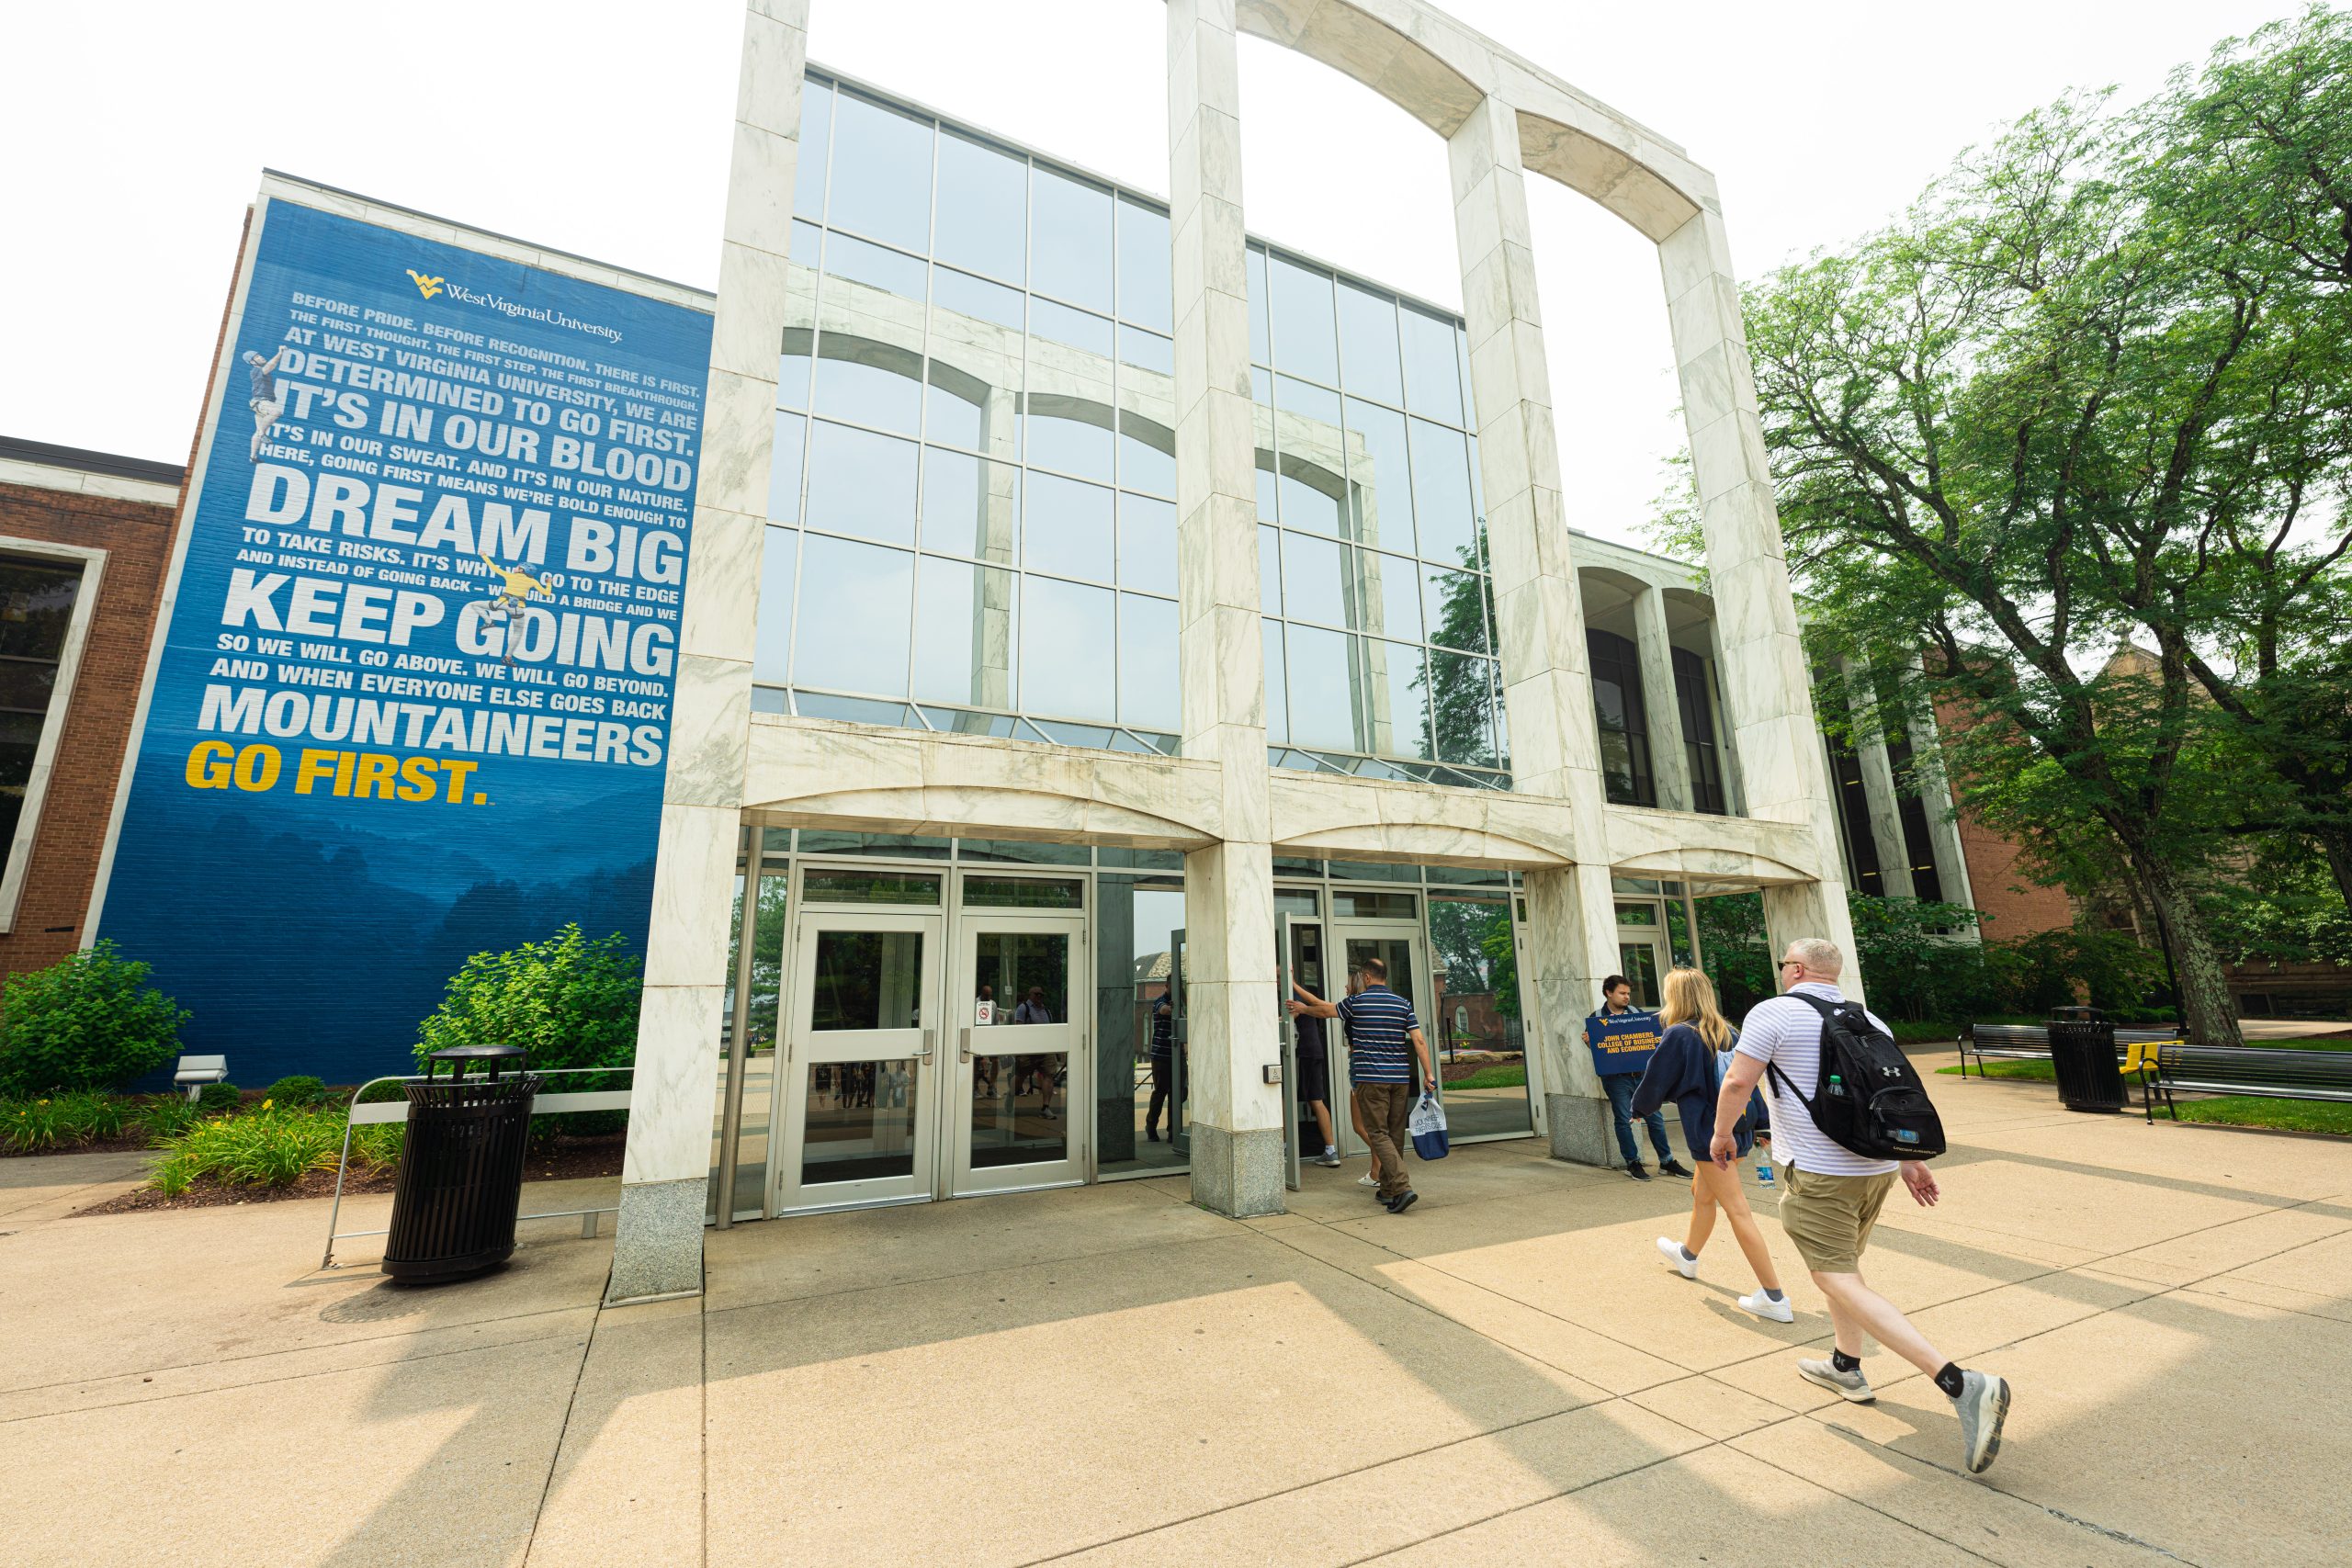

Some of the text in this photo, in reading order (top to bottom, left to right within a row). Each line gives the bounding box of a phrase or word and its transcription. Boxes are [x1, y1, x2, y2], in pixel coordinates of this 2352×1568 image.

[284, 326, 696, 430] AT WEST VIRGINIA UNIVERSITY, WE ARE
[289, 309, 697, 412] THE FIRST THOUGHT. THE FIRST STEP. THE FIRST BREAKTHROUGH.
[292, 291, 699, 398] BEFORE PRIDE. BEFORE RECOGNITION. THERE IS FIRST.
[274, 378, 691, 491] IT'S IN OUR BLOOD
[278, 348, 693, 457] DETERMINED TO GO FIRST.
[258, 443, 685, 528] HERE, GOING FIRST MEANS WE'RE BOLD ENOUGH TO
[310, 429, 334, 447] IN
[339, 435, 382, 457] OUR
[389, 445, 460, 470] SWEAT.
[467, 459, 507, 479] AND
[513, 468, 547, 486] IT'S
[551, 475, 571, 491] IN
[576, 479, 612, 498] OUR
[617, 487, 687, 512] NATURE.
[242, 526, 270, 544] TO
[277, 531, 332, 554] TAKE
[337, 541, 405, 565] RISKS.
[412, 552, 449, 570] IT'S
[570, 575, 592, 592] TO
[597, 580, 630, 597] THE
[635, 585, 678, 604] EDGE
[244, 462, 683, 585] DREAM BIG
[220, 567, 673, 676] KEEP GOING
[235, 548, 274, 564] AND
[277, 554, 348, 574] INSTEAD
[353, 565, 374, 578] OF
[378, 569, 425, 585] GOING
[429, 576, 470, 592] BACK
[559, 594, 569, 605] A
[572, 596, 622, 613] BRIDGE
[625, 604, 652, 616] AND
[657, 607, 676, 620] WE
[209, 658, 665, 720] AND WHEN EVERYONE ELSE GOES BACK
[216, 633, 668, 697] SO WE WILL GO ABOVE. WE WILL GO BEYOND.
[197, 683, 662, 766] MOUNTAINEERS
[185, 739, 487, 805] GO FIRST.
[1597, 1041, 1623, 1049] COLLEGE
[1604, 1032, 1655, 1043] JOHN CHAMBERS
[1621, 1043, 1656, 1053] ECONOMICS
